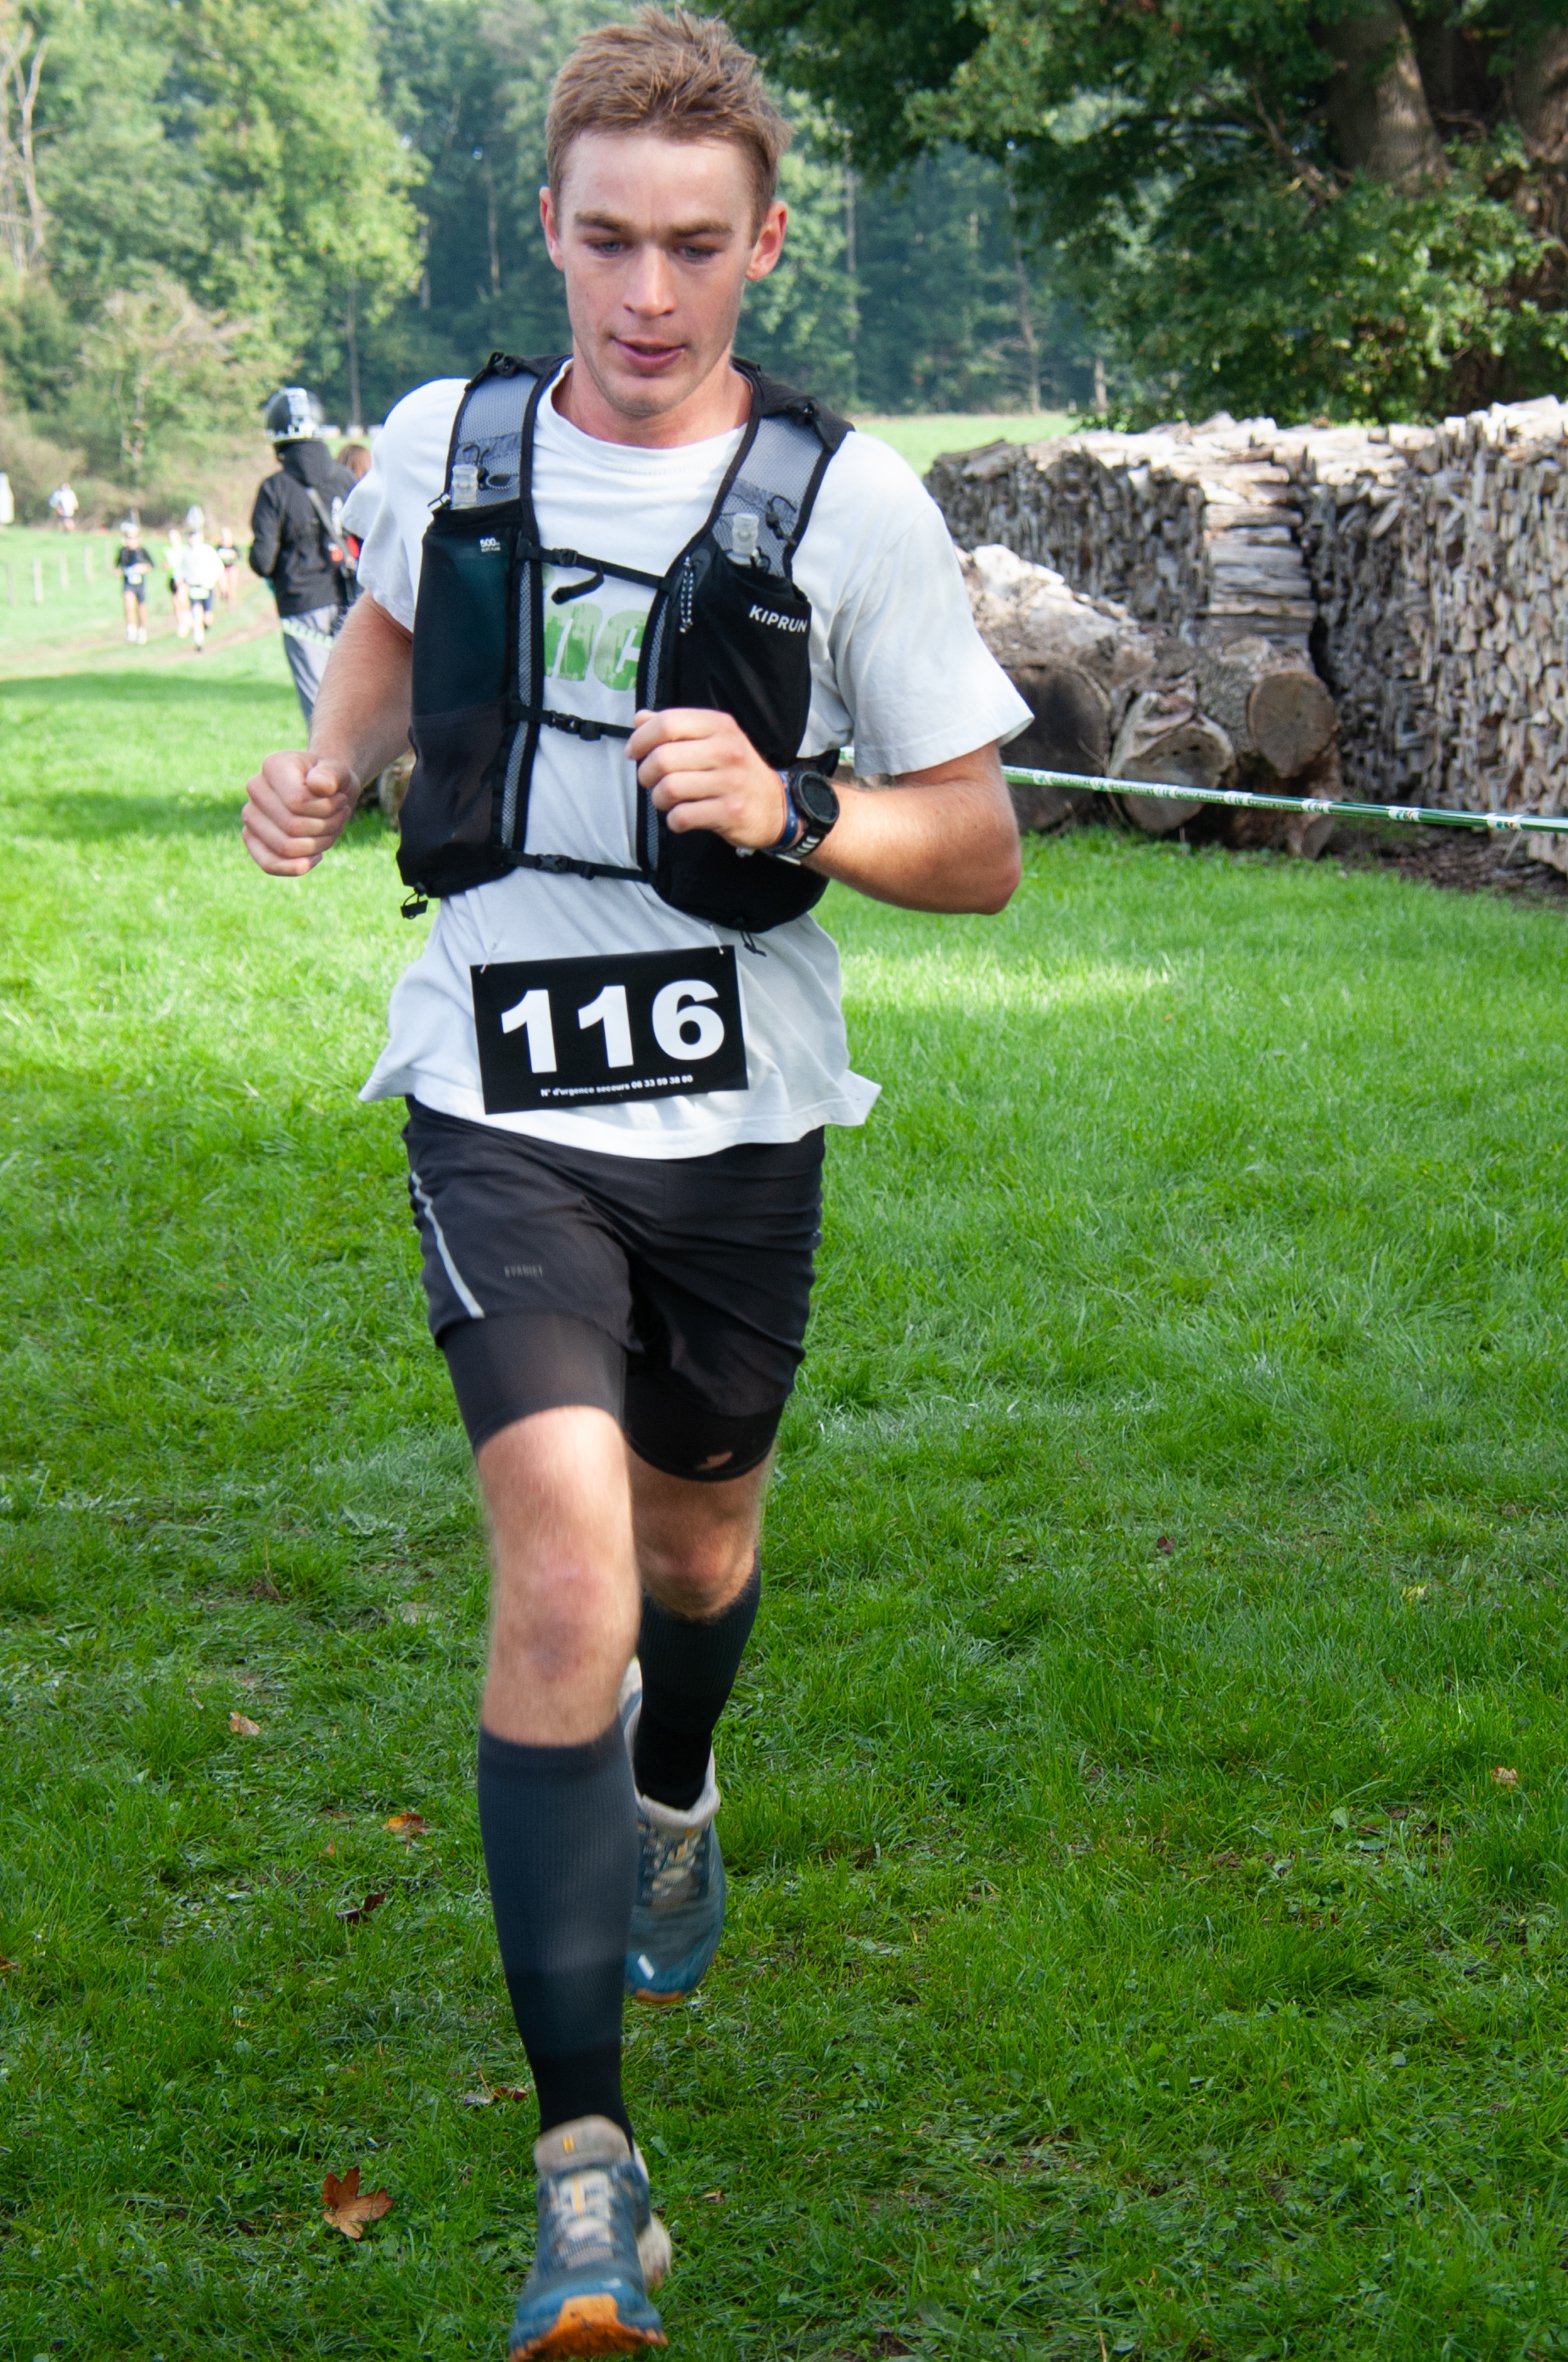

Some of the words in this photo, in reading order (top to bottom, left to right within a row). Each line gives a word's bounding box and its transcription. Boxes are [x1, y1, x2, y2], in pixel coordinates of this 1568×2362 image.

[749, 604, 808, 633] KIPRUN
[501, 979, 725, 1074] 116
[552, 1086, 595, 1097] d'urgence
[596, 1083, 631, 1094] secours
